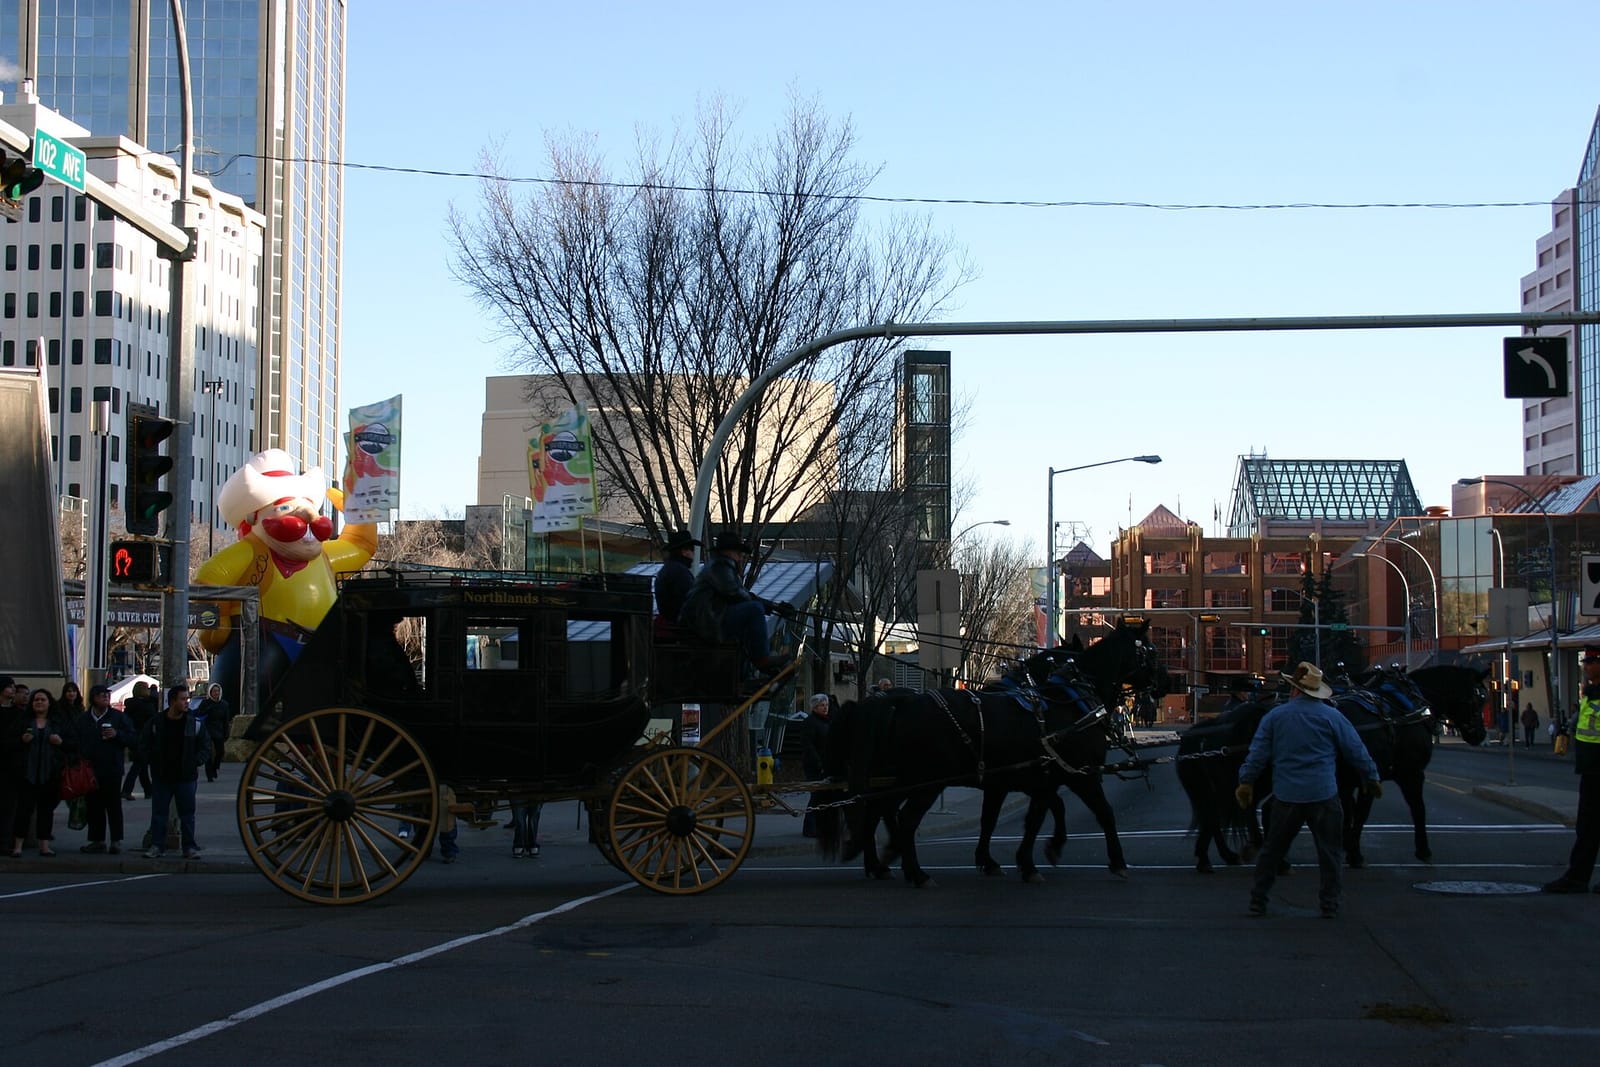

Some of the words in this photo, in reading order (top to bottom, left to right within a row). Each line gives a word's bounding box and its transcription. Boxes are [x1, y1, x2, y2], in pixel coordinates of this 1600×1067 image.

[39, 138, 57, 169] 102
[62, 152, 82, 183] AVE
[463, 591, 540, 605] Northlands
[117, 611, 141, 623] RIVER
[142, 612, 160, 624] CITY
